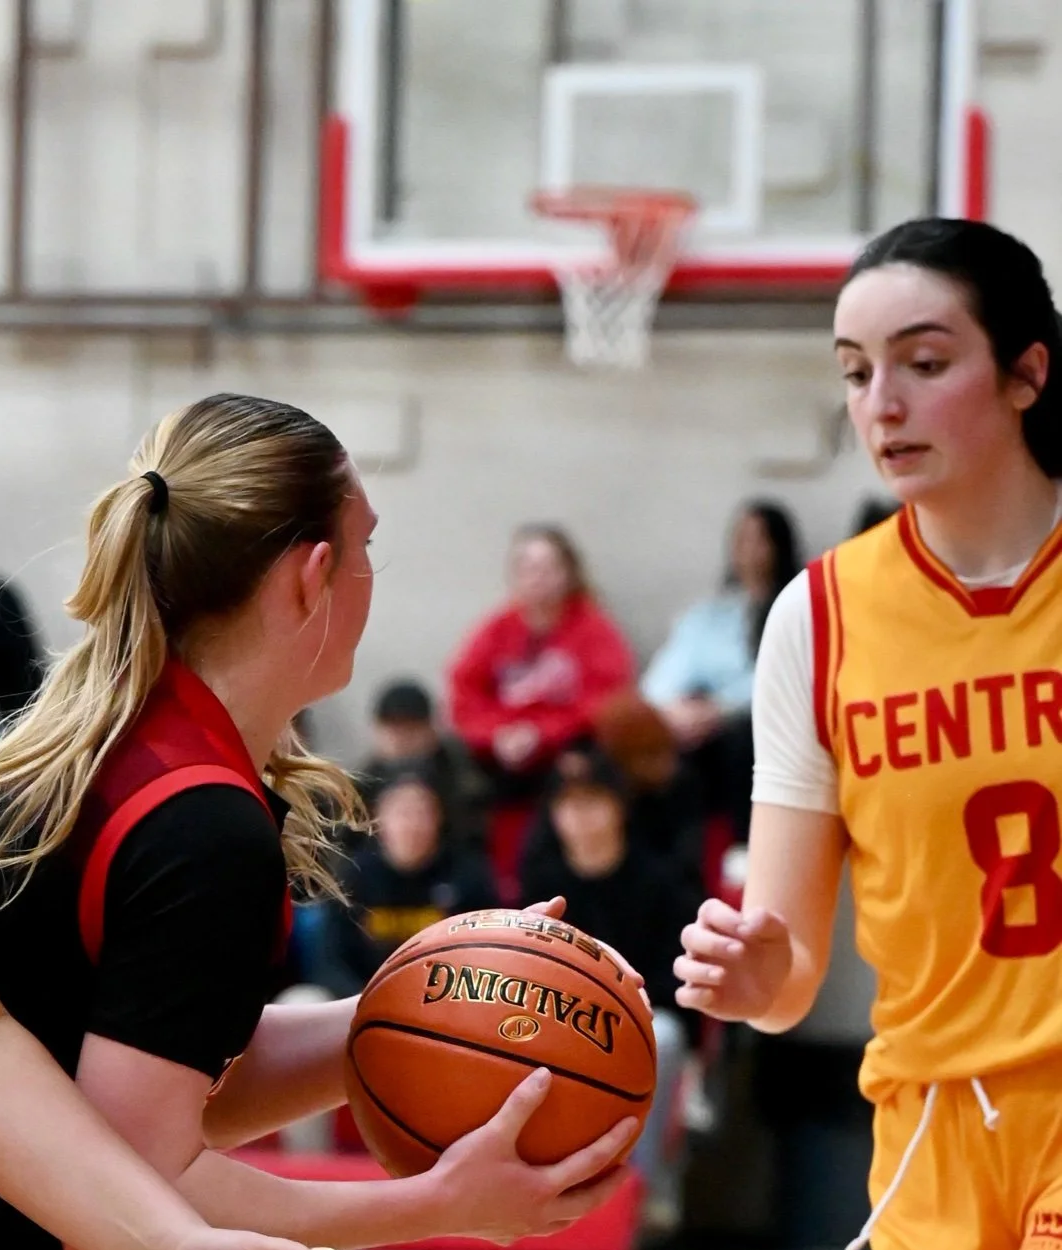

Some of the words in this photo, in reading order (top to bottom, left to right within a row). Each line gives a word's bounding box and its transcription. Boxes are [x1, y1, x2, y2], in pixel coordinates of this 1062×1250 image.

[844, 669, 1062, 780] CENTR
[963, 779, 1062, 958] 8
[422, 960, 622, 1055] SPALDING
